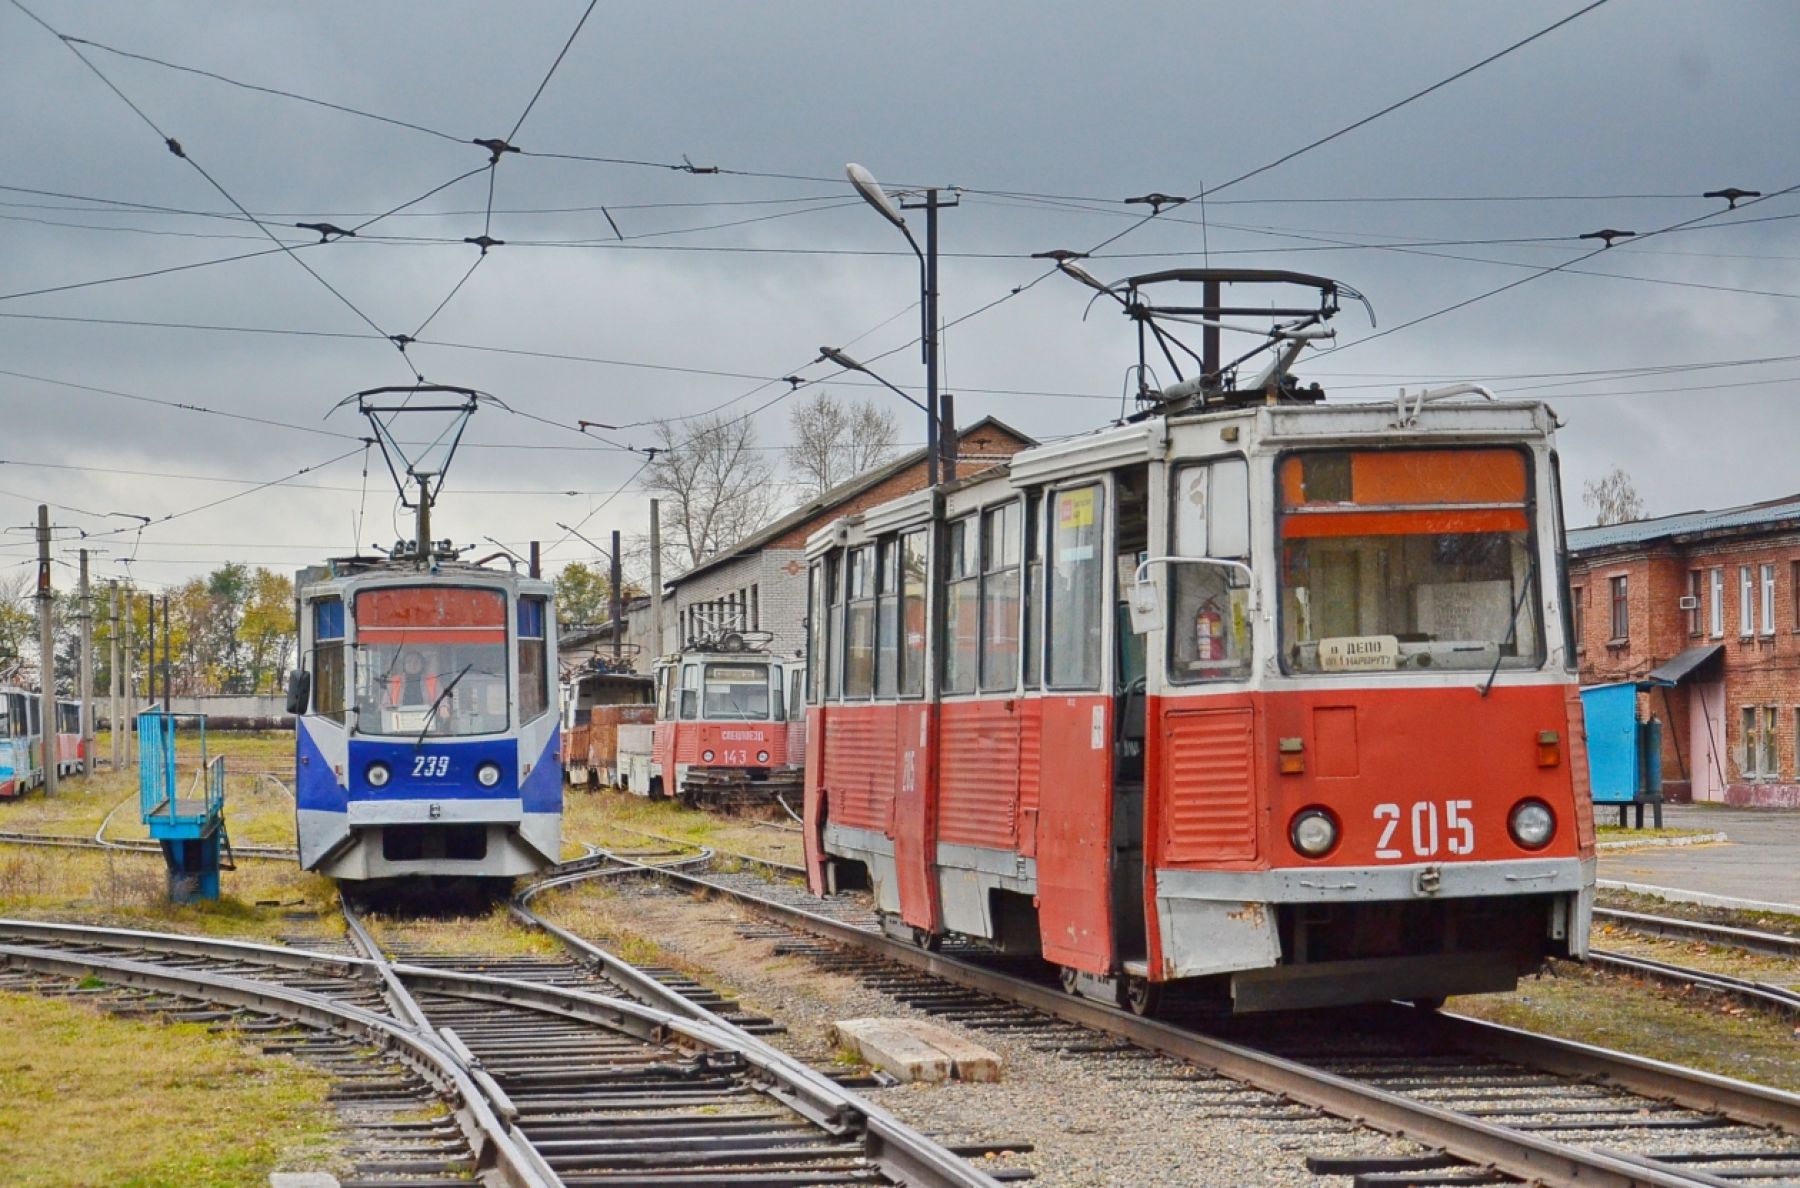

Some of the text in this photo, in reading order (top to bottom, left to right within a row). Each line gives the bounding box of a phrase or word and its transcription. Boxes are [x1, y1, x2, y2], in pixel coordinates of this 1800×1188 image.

[1347, 641, 1382, 655] ДЕПО
[411, 755, 450, 777] 239
[723, 749, 747, 765] 143
[1373, 799, 1475, 859] 205
